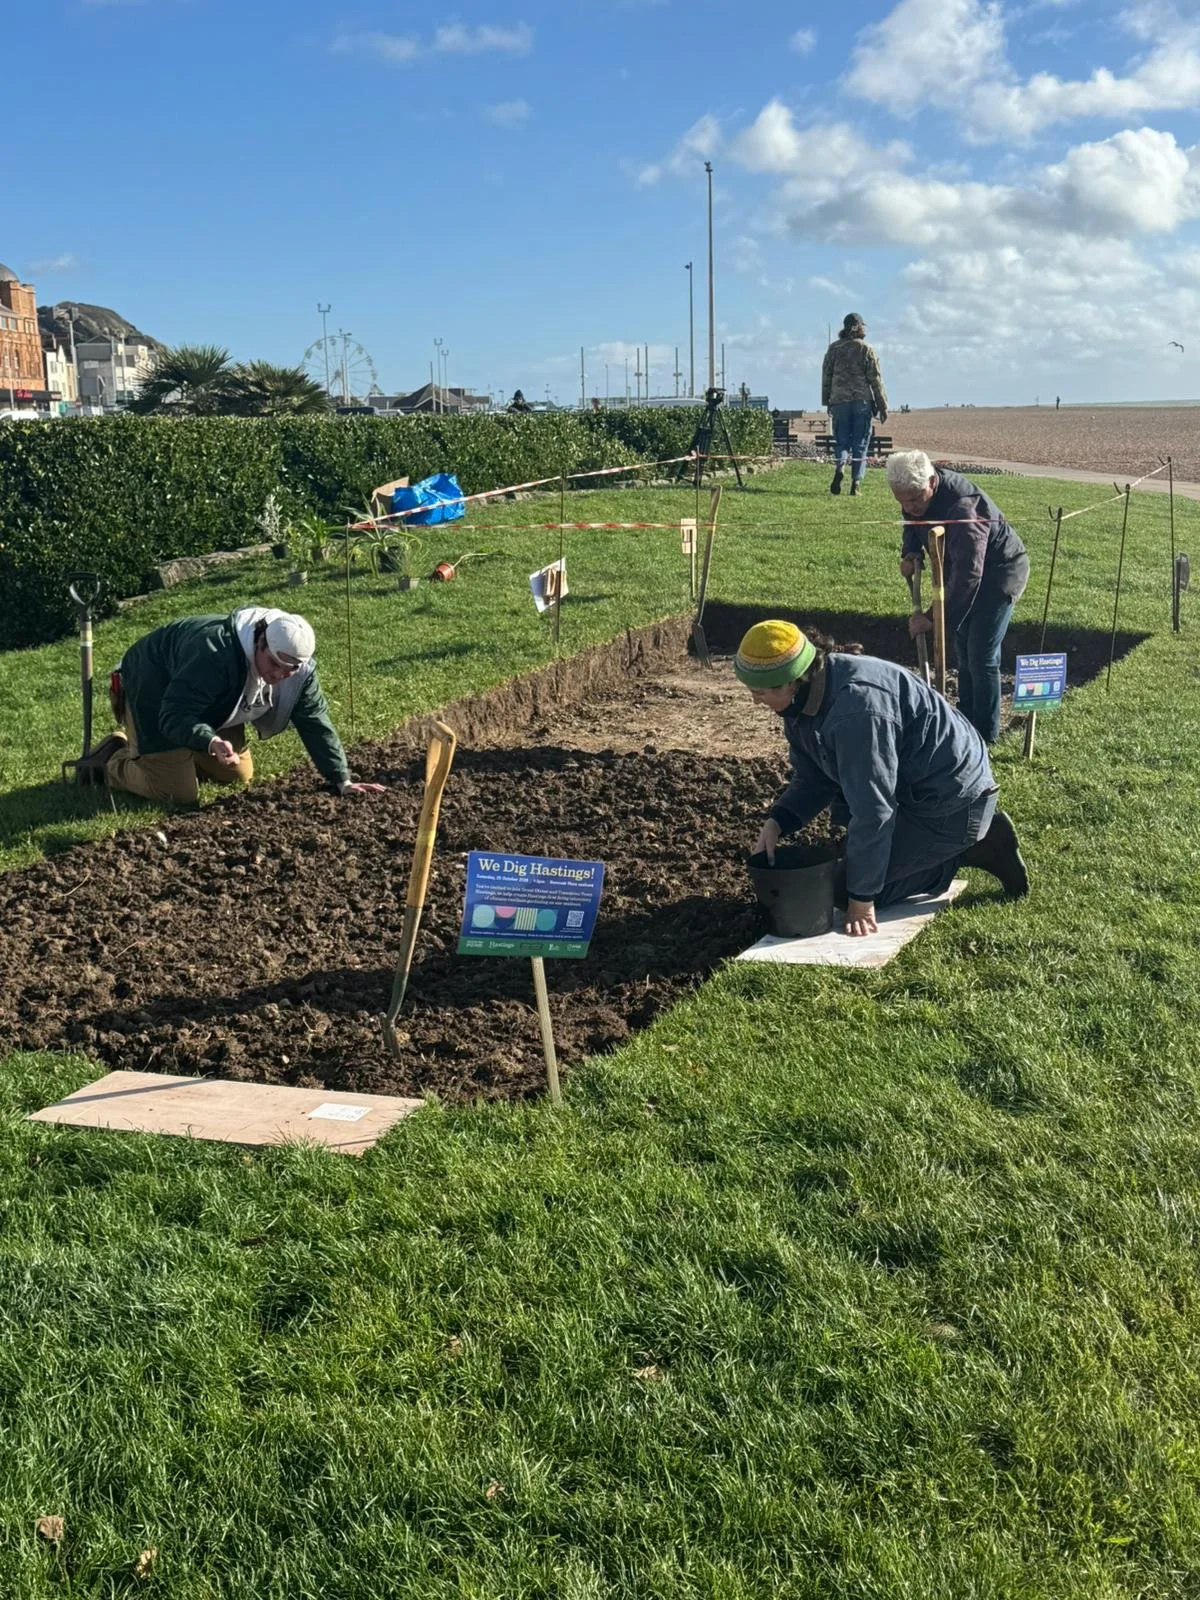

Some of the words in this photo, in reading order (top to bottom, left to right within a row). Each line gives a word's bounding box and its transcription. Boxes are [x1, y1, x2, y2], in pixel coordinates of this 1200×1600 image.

[1020, 658, 1029, 666] We
[1029, 658, 1039, 667] Dig
[478, 858, 500, 871] We
[503, 860, 528, 876] Dig
[530, 863, 595, 881] Hastings!
